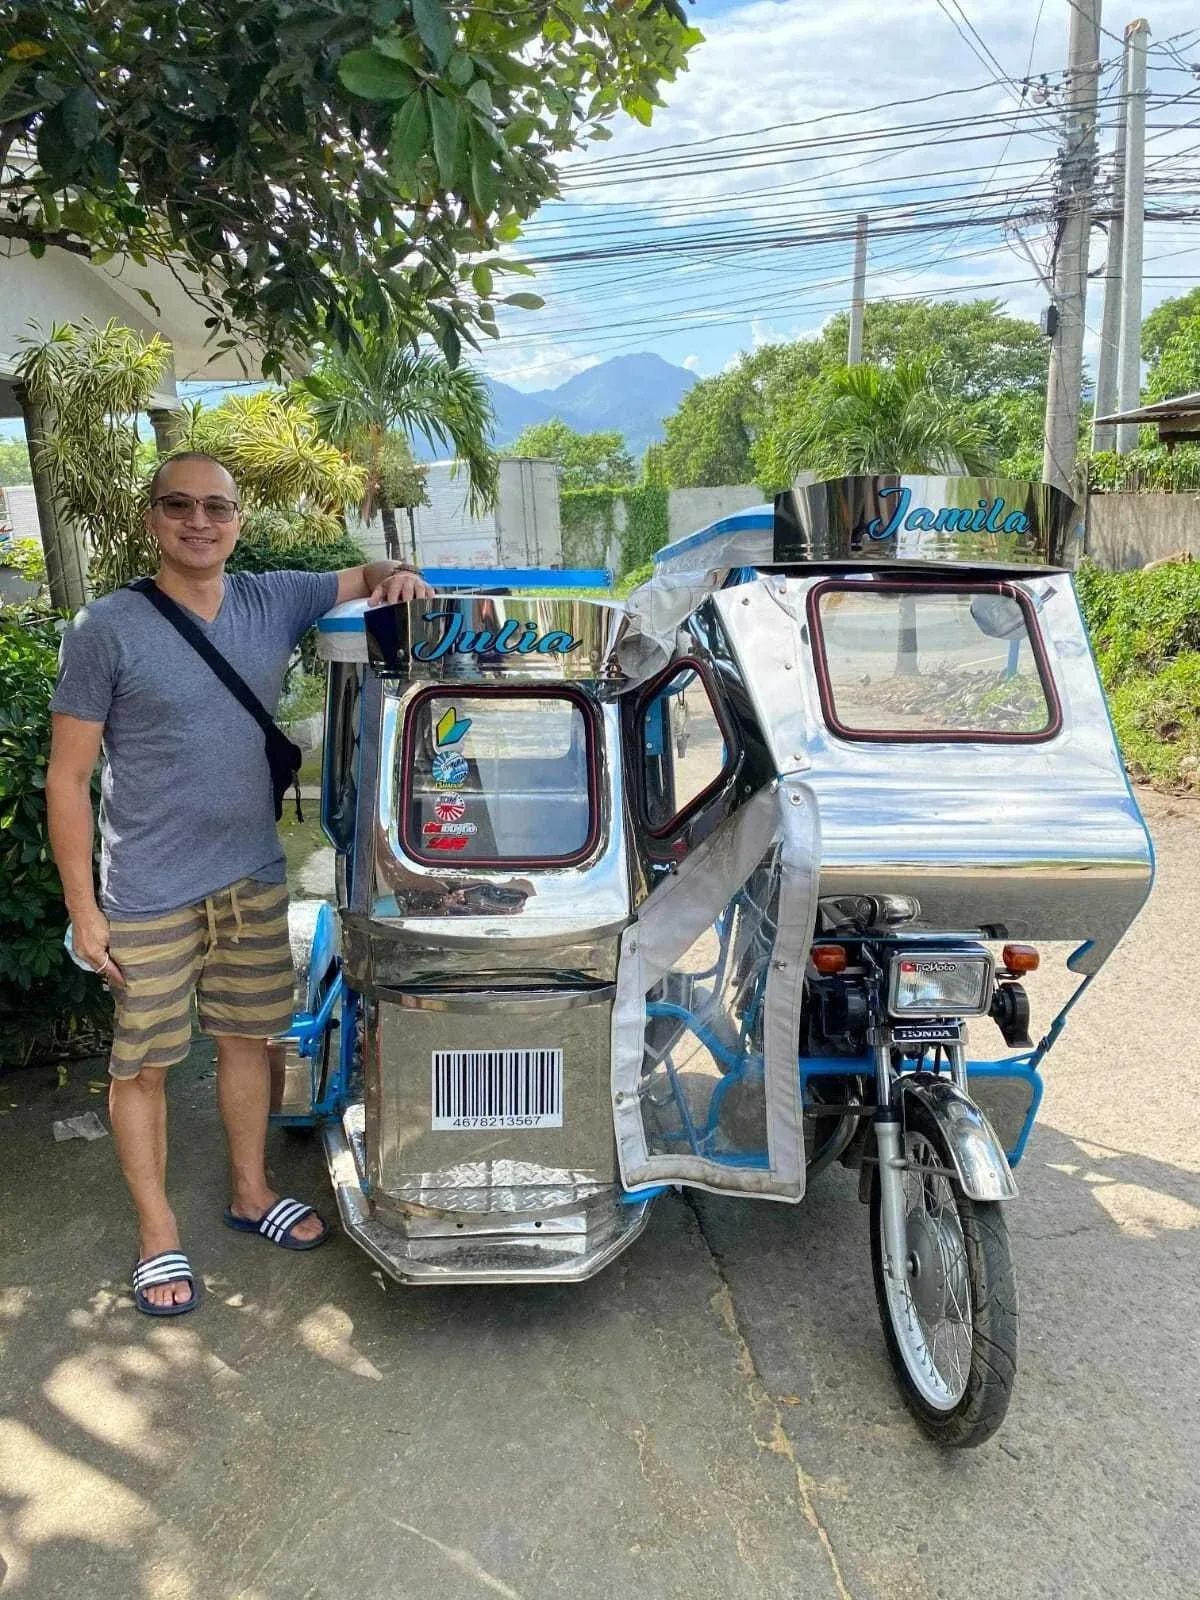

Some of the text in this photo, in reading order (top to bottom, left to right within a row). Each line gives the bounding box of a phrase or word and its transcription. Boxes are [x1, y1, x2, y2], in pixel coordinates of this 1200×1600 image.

[867, 487, 1031, 540] Jamila
[412, 610, 583, 661] Julia
[901, 1030, 952, 1038] HONDA
[453, 1116, 542, 1127] 4678213567
